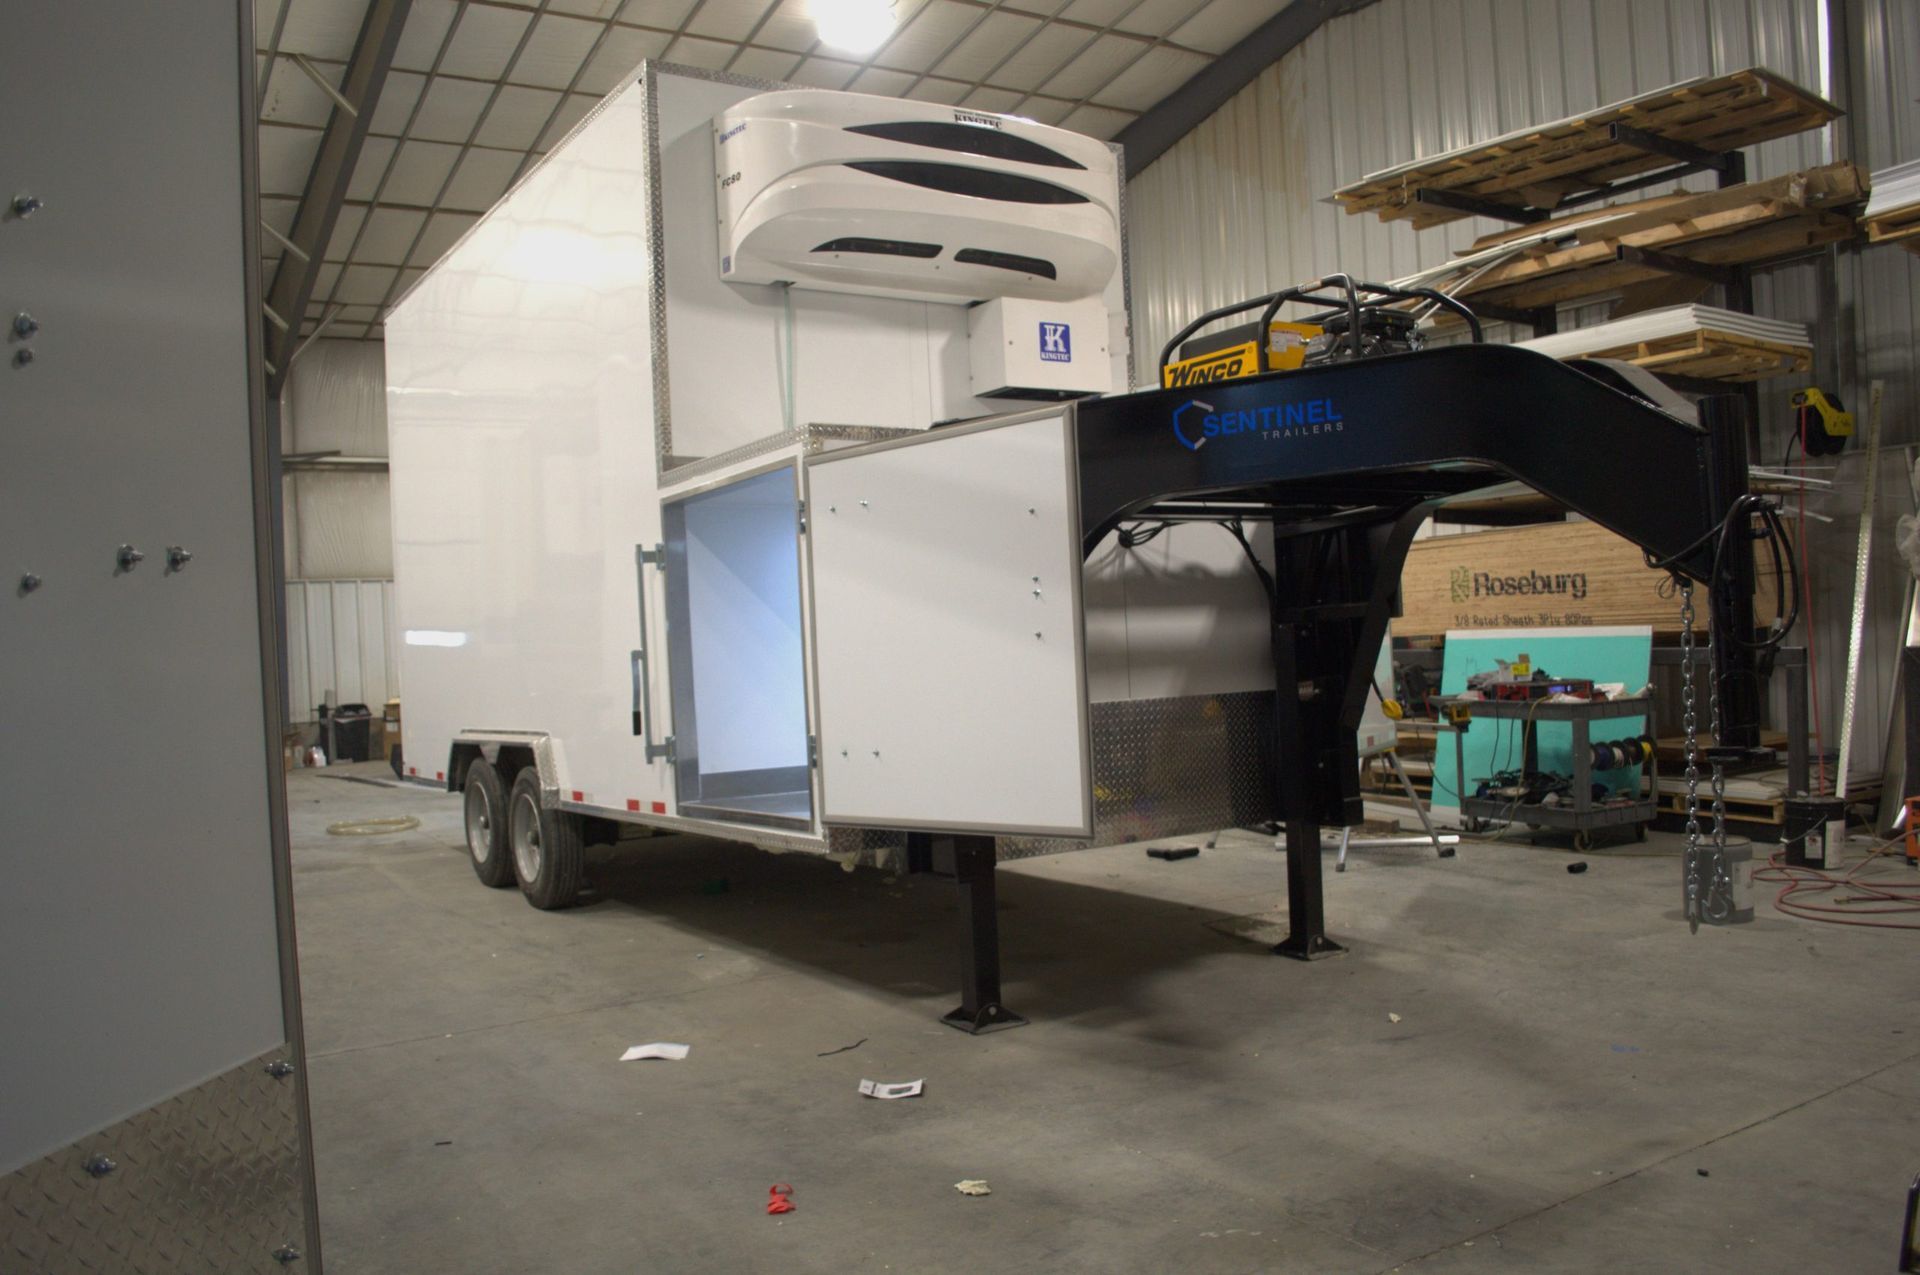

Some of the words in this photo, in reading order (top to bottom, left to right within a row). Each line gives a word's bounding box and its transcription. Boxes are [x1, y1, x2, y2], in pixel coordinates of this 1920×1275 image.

[954, 112, 1002, 129] KINGTEC
[1041, 351, 1070, 361] KINGTEC
[1168, 358, 1243, 387] WINCO
[1203, 398, 1343, 437] SENTINEL
[1262, 422, 1345, 440] TRAILERS
[1473, 569, 1587, 599] Roseburg
[1473, 614, 1499, 627] Rated
[1502, 612, 1534, 626] Sheath
